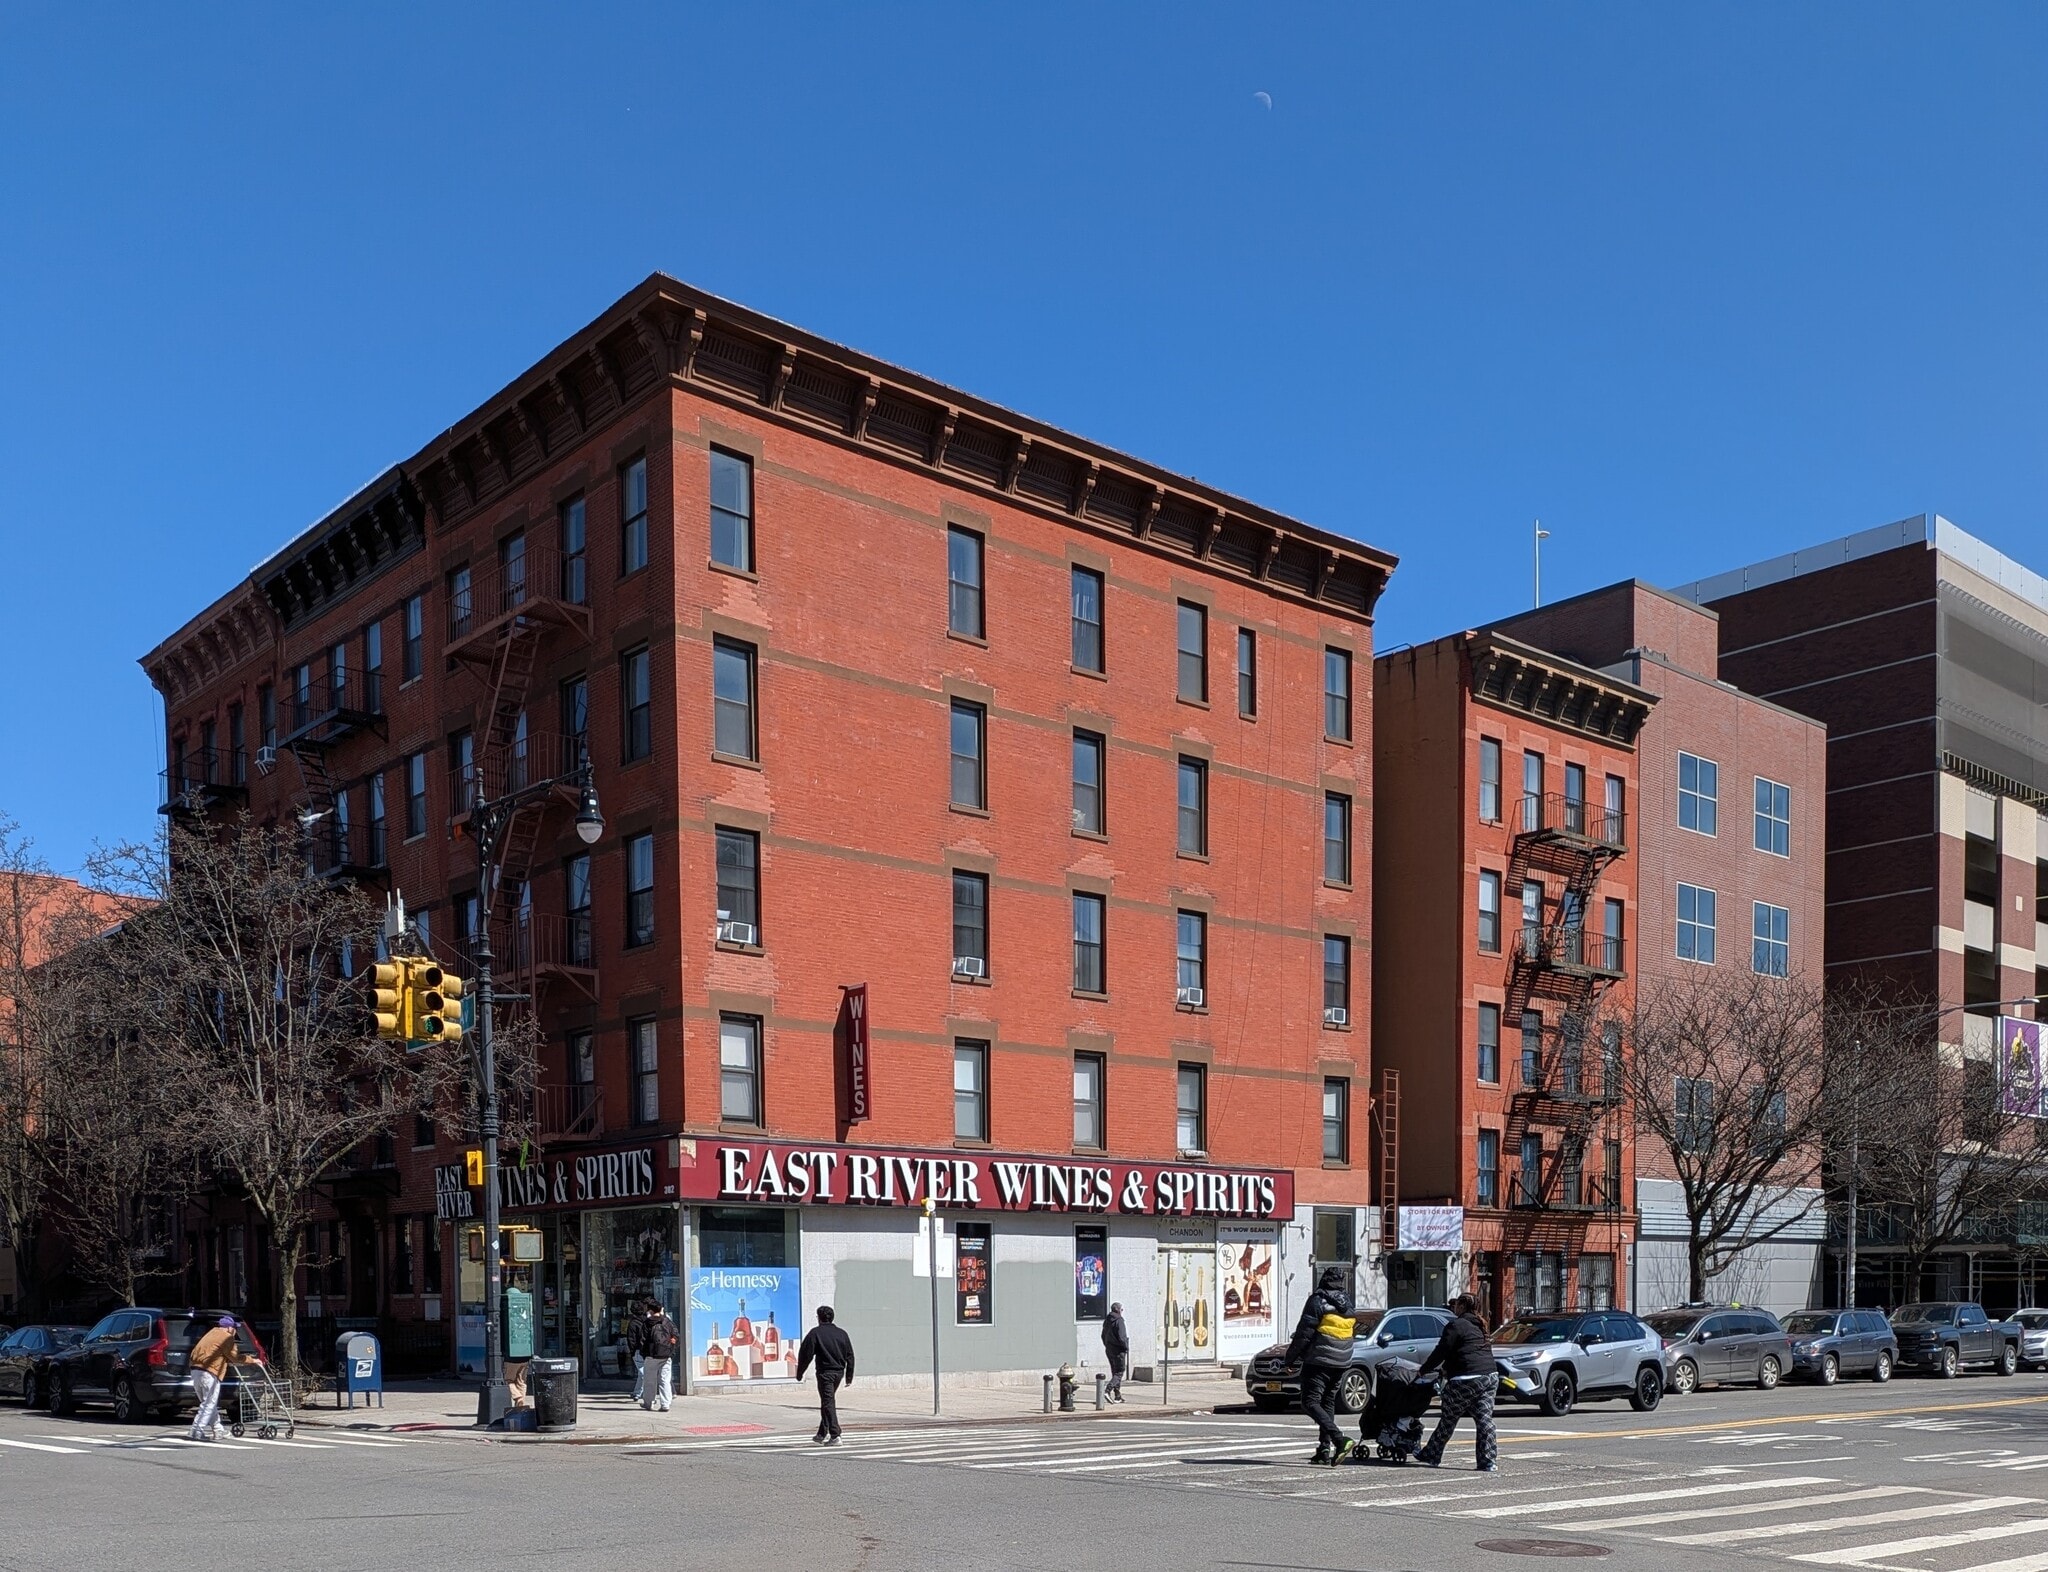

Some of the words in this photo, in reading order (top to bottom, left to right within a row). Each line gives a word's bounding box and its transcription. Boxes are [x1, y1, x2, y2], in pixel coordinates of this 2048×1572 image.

[849, 994, 865, 1115] WINES
[434, 1164, 463, 1194] EAST
[553, 1159, 569, 1204] &
[575, 1148, 653, 1202] SPIRITS
[721, 1147, 838, 1198] EAST
[848, 1154, 982, 1203] RIVER
[992, 1161, 1114, 1209] WINES
[1122, 1169, 1149, 1210] &
[1156, 1170, 1276, 1215] SPIRITS
[436, 1189, 474, 1219] RIVER
[1169, 1227, 1204, 1237] CHANDON
[711, 1270, 782, 1292] Hennessy
